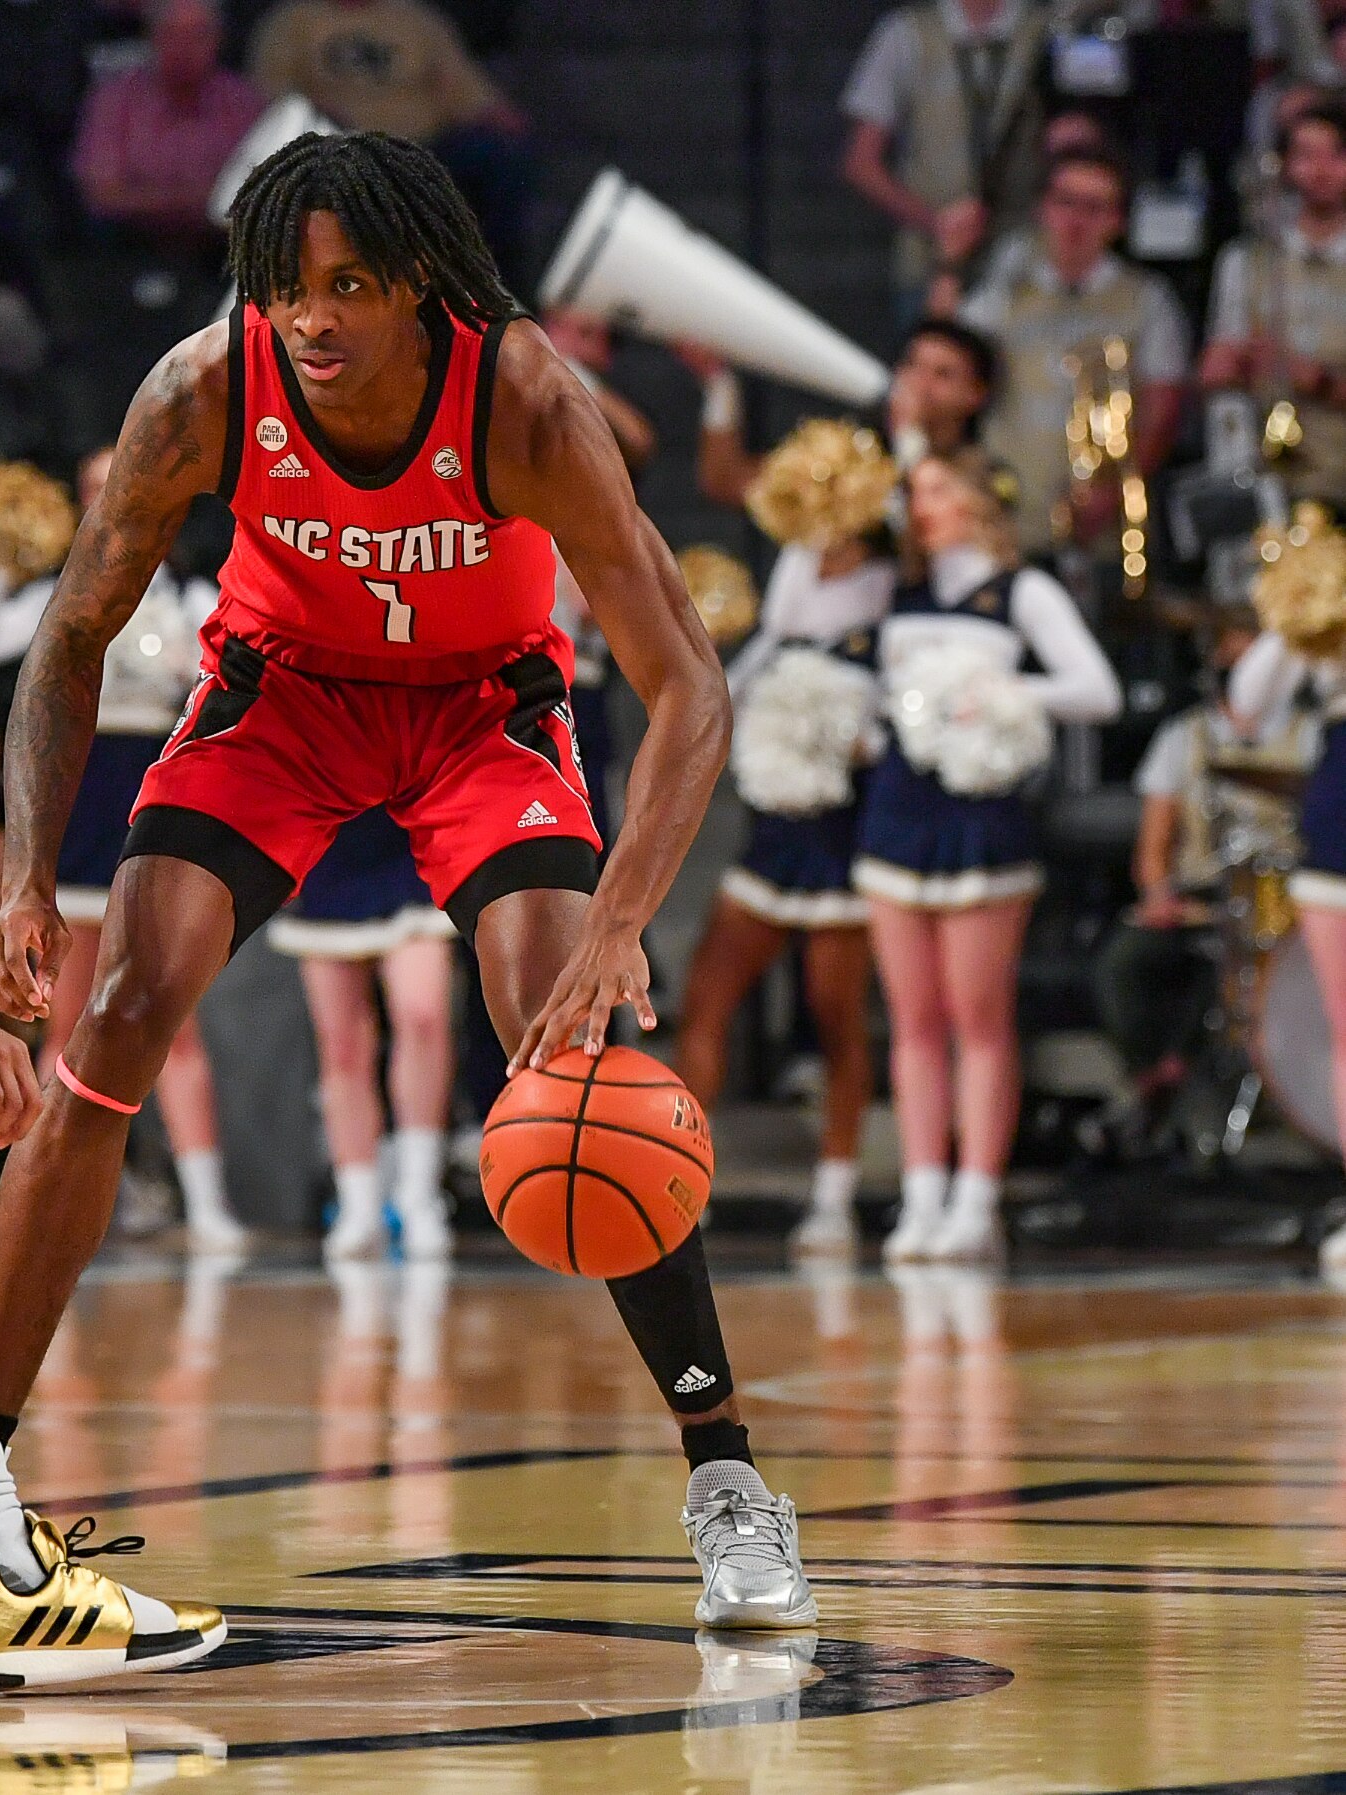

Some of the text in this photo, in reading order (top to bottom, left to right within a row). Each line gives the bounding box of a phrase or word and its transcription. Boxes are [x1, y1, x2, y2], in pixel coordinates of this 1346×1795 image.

[262, 425, 281, 434] PACK
[259, 433, 285, 443] UNITED
[437, 456, 461, 465] ACC
[268, 468, 310, 478] adidas
[263, 515, 490, 574] NC STATE
[359, 575, 416, 643] 1
[517, 815, 558, 829] adidas
[674, 1374, 717, 1393] adidas
